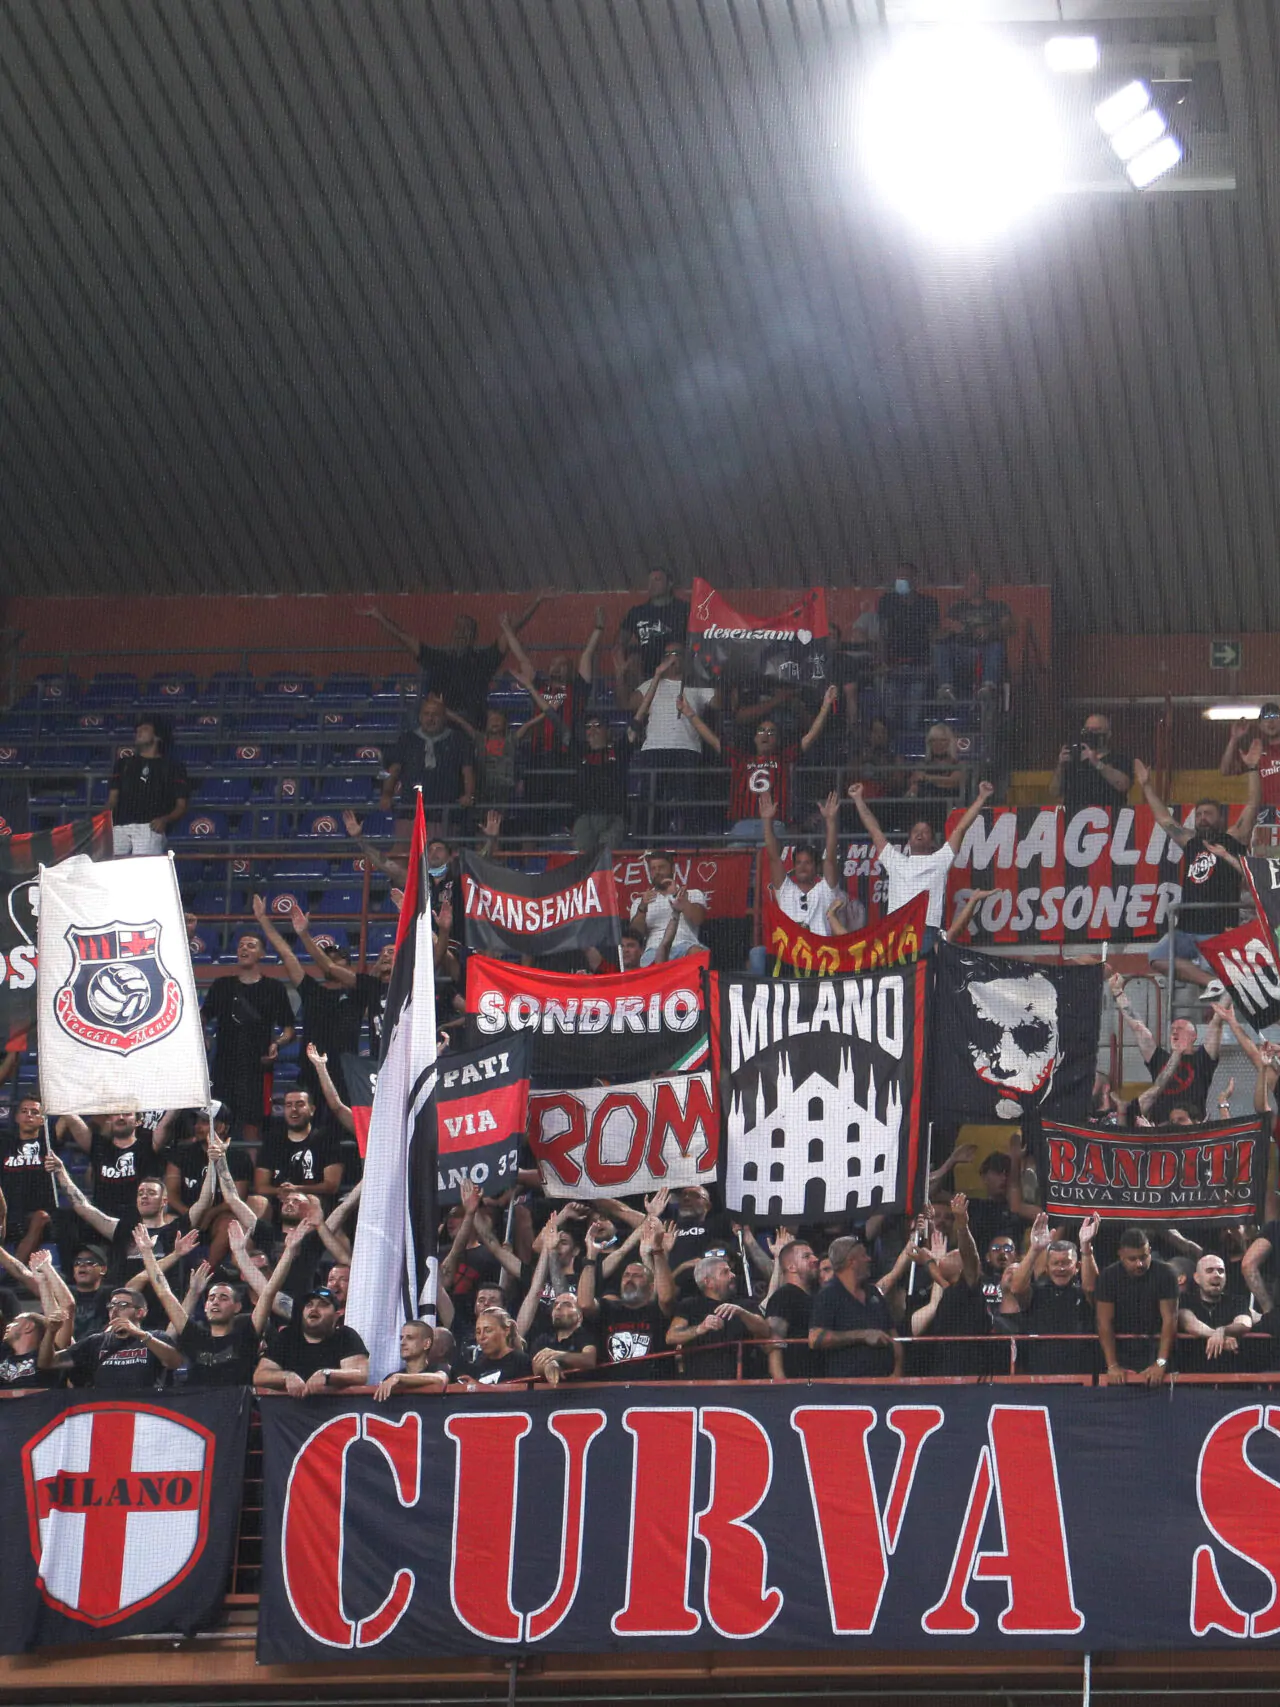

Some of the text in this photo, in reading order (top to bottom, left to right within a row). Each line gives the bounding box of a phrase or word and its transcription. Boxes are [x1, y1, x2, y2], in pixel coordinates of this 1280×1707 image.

[749, 769, 770, 793] 6
[464, 876, 602, 931] TRANSENNA
[476, 988, 700, 1035] SONDRIO
[729, 975, 904, 1075] MILANO
[443, 1108, 498, 1139] VIA
[1048, 1137, 1256, 1189] BANDITI
[1050, 1185, 1252, 1204] CURVA SUD MILANO
[281, 1402, 1086, 1650] CURVA
